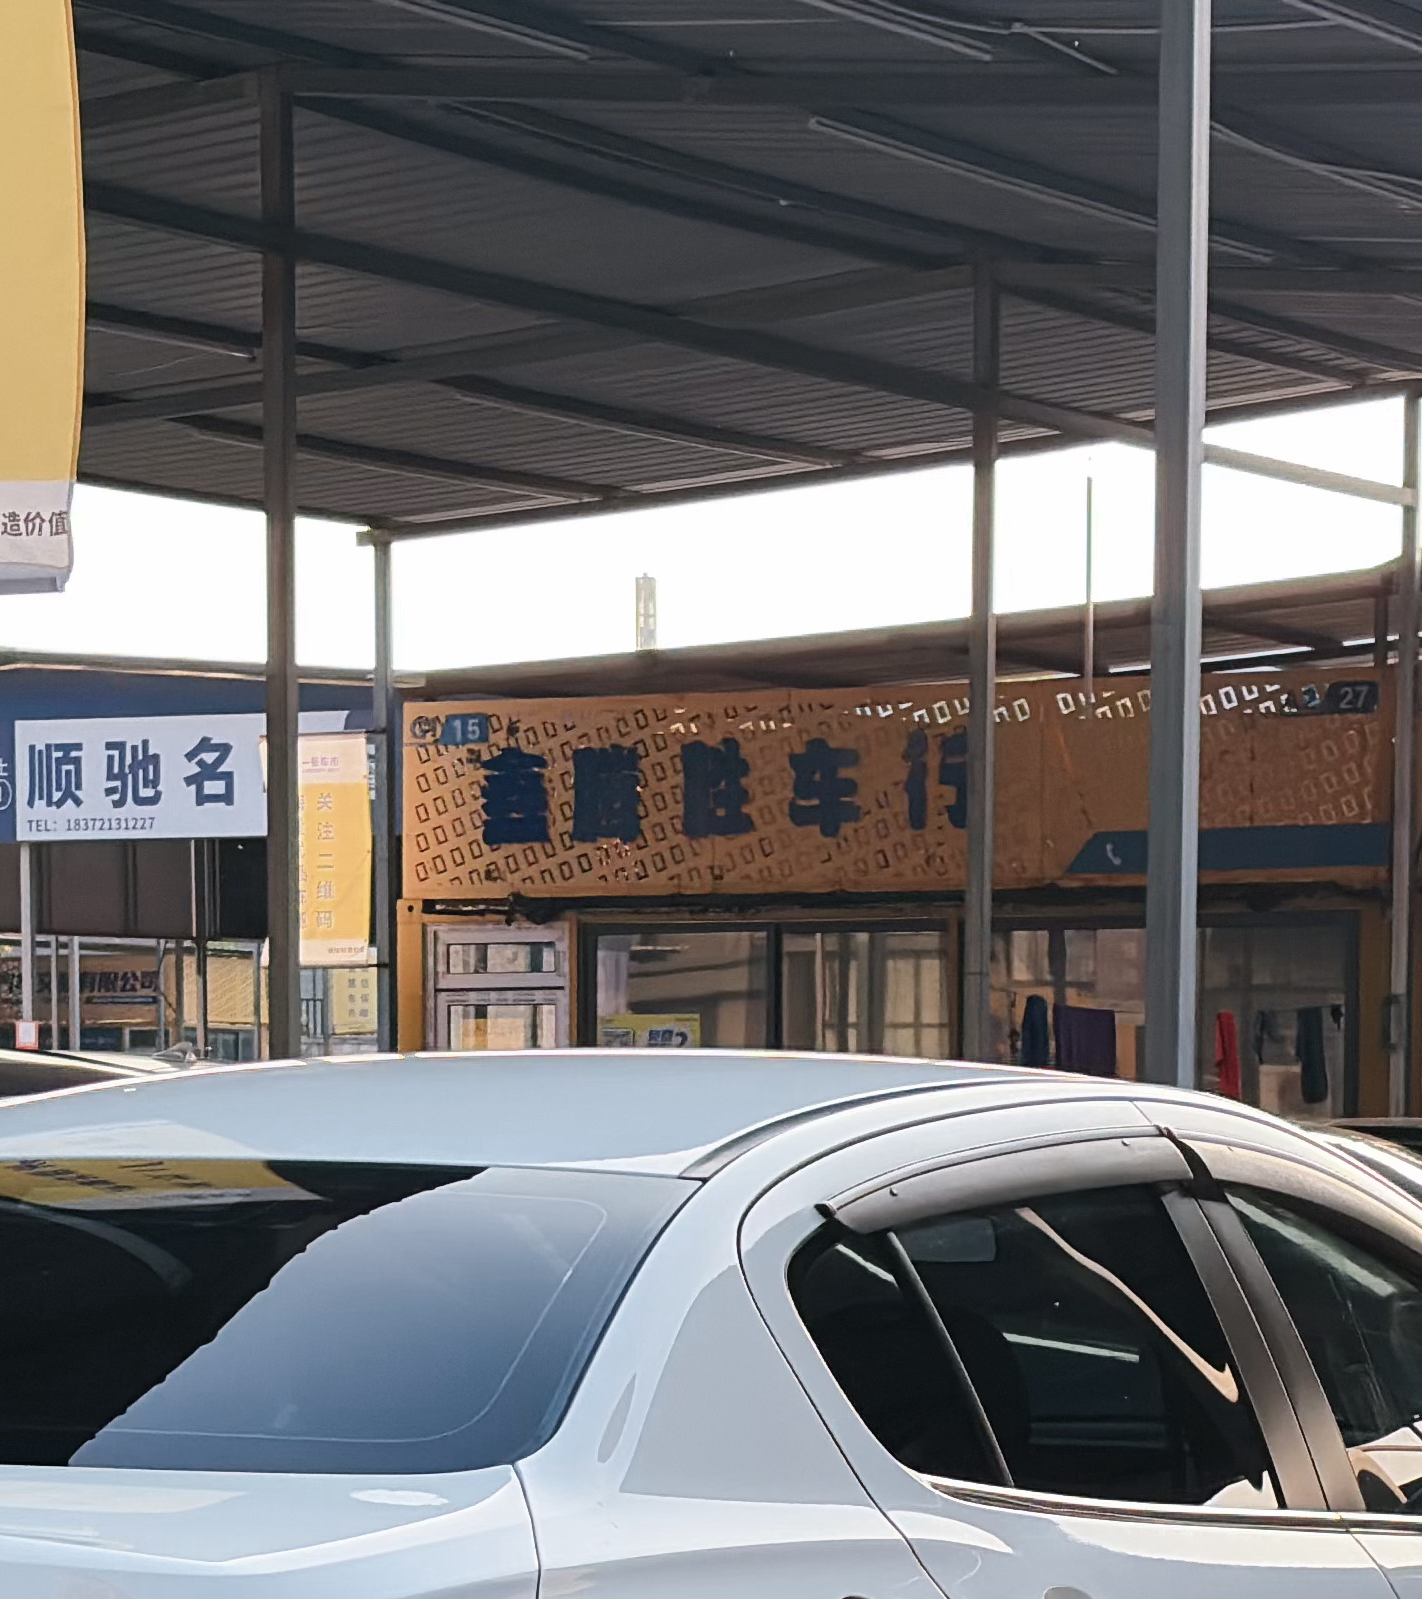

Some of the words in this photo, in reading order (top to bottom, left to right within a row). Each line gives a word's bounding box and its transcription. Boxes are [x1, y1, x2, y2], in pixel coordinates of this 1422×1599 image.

[453, 719, 479, 743] 15
[27, 736, 235, 809] 顺驰名
